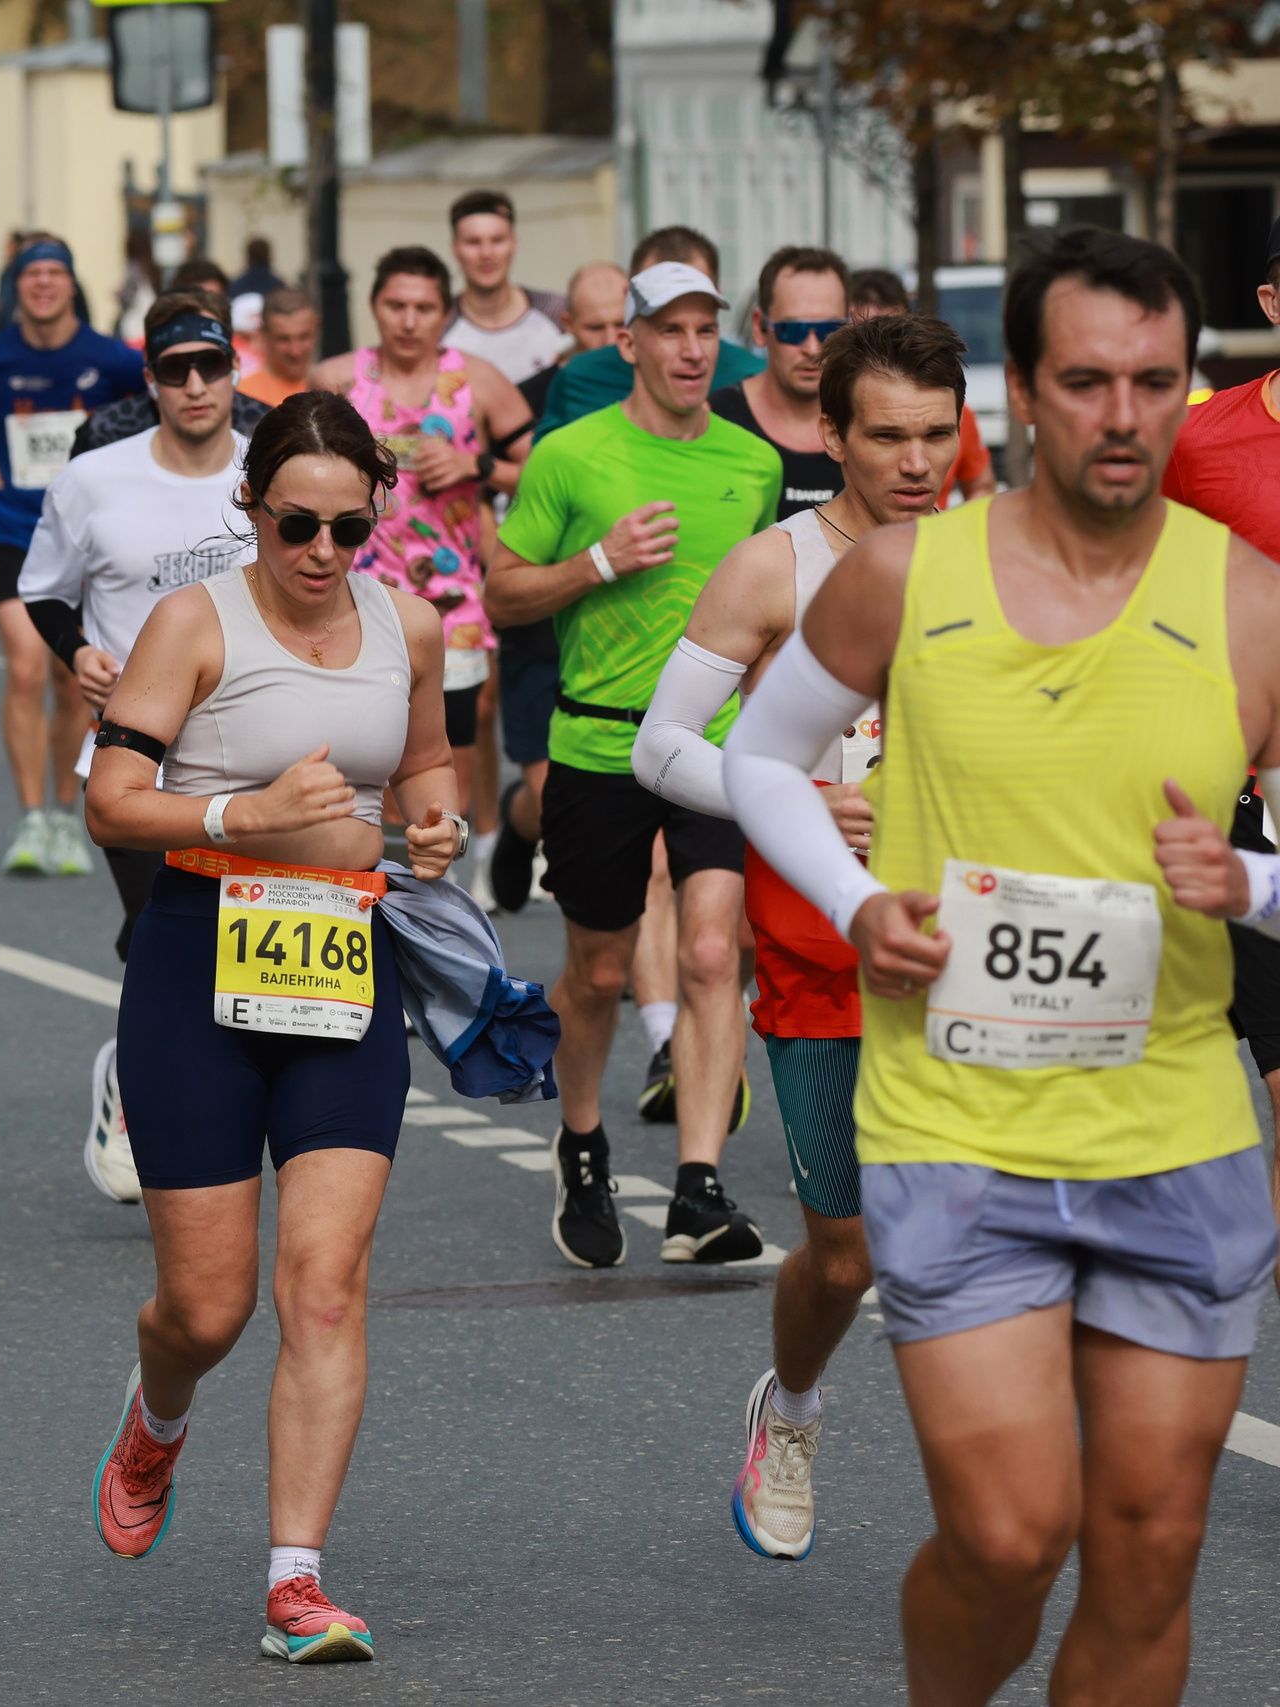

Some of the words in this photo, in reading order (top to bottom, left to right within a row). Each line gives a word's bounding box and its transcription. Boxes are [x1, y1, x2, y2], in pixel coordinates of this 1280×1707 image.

[268, 890, 324, 901] МОСКОВСКИЙ
[269, 884, 310, 892] СБЕРПРАЙМ
[330, 892, 344, 902] 42,2
[268, 898, 310, 907] МАРАФОН
[229, 918, 368, 976] 14168
[985, 922, 1107, 989] 854
[260, 972, 341, 990] ВАЛЕНТИНА
[1010, 992, 1074, 1011] VITALY
[232, 998, 250, 1024] E
[946, 1021, 973, 1054] C
